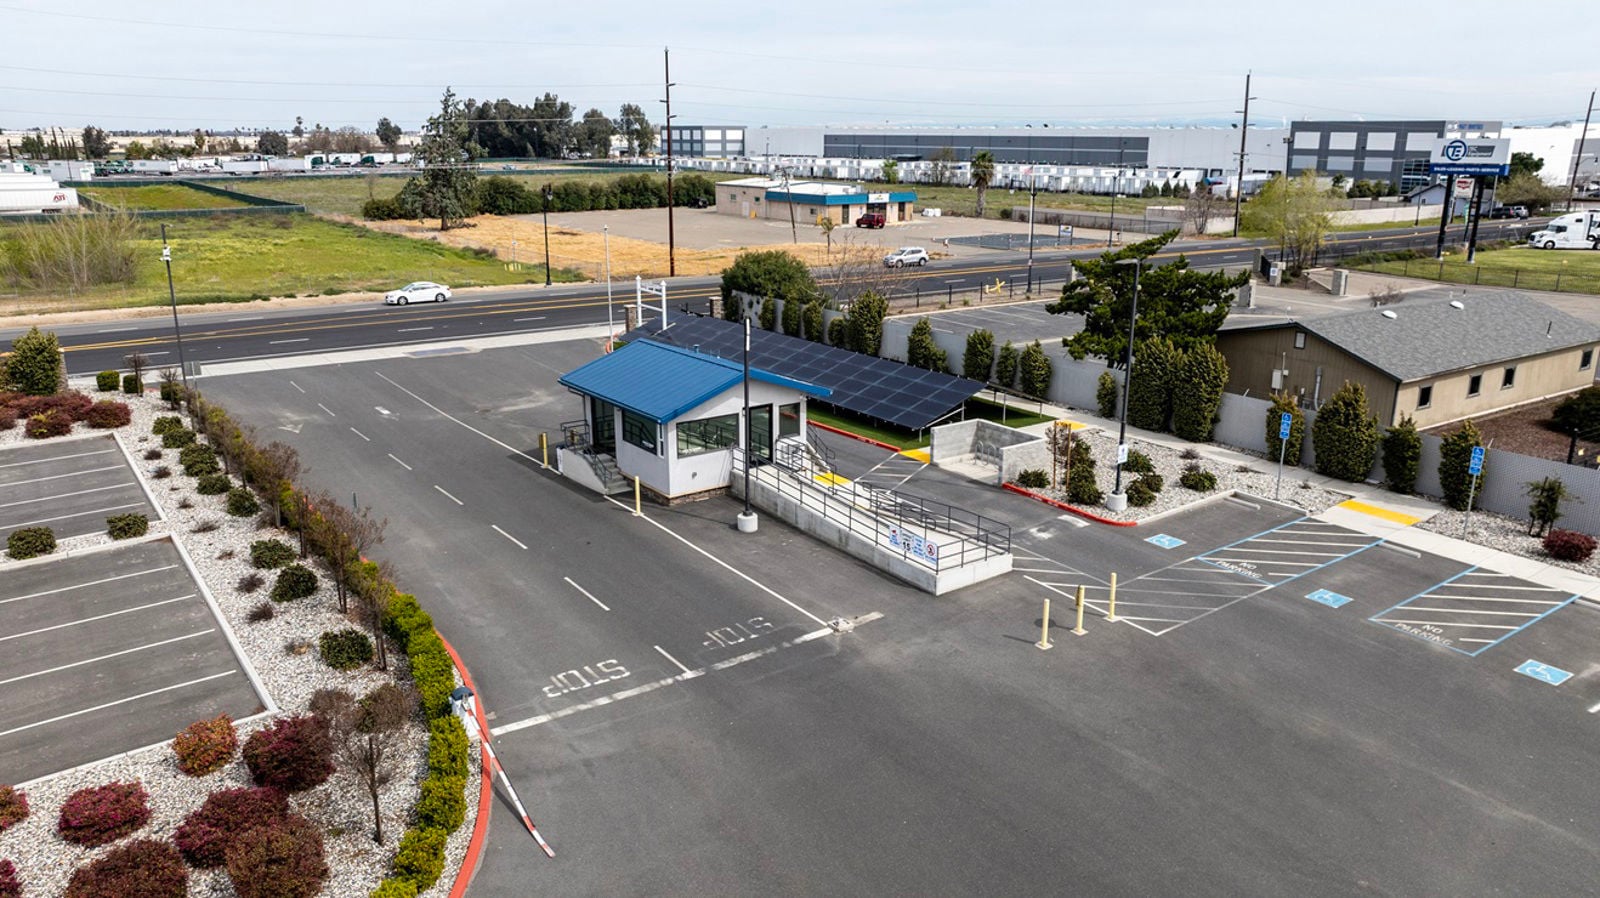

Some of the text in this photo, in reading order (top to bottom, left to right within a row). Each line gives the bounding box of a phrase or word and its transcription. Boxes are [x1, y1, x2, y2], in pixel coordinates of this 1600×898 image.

[1238, 562, 1257, 570] NO
[702, 616, 774, 650] STOP
[1394, 622, 1454, 645] PARKING
[1422, 624, 1444, 634] NO
[542, 658, 632, 698] STOP
